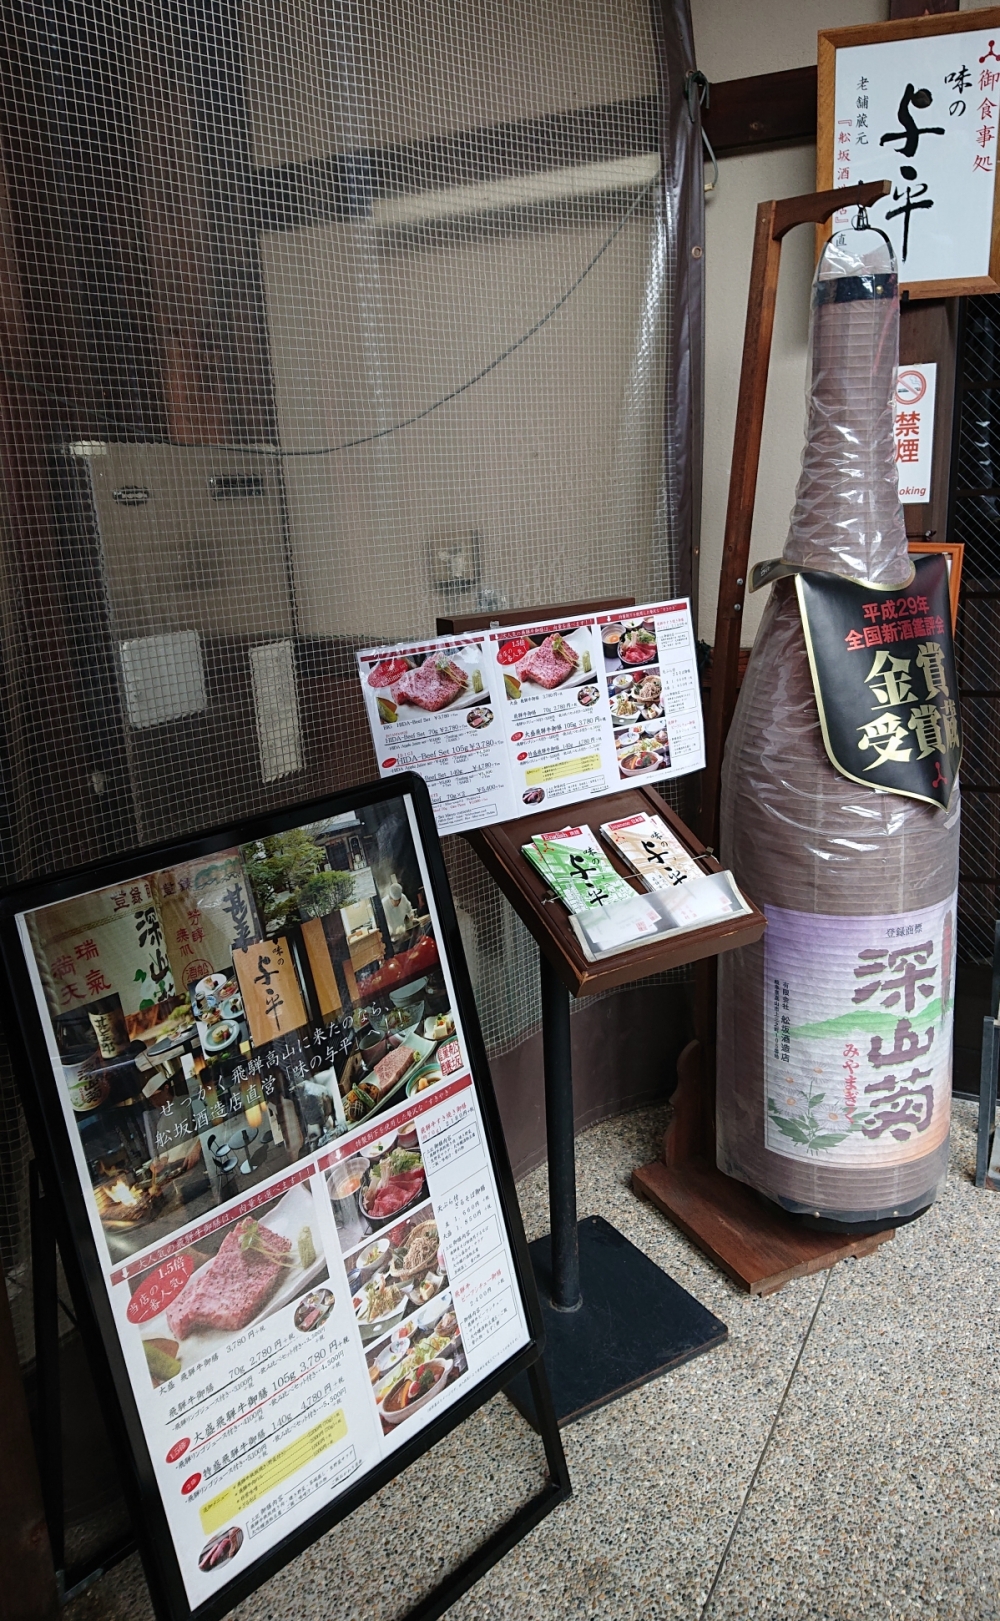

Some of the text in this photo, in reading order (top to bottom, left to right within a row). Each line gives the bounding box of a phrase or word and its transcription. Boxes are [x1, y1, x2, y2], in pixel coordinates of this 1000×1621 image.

[855, 76, 869, 146] 老舗蔵元
[944, 65, 973, 117] 味の
[972, 69, 1000, 173] 御食事処
[895, 411, 920, 462] 禁煙
[899, 487, 926, 497] oking
[844, 615, 945, 651] 全国新酒鑑評会
[862, 596, 930, 623] 平成29年
[864, 642, 950, 710] 金賞
[563, 721, 577, 730] 105g
[397, 750, 437, 765] HIDA-Beef
[452, 745, 469, 754] 105g
[469, 740, 494, 750] ¥3,780
[886, 923, 923, 938] 登録商標
[157, 997, 390, 1119] せっかく飛騨高山に来たのなら、
[851, 940, 938, 1141] 深山菊
[843, 1043, 860, 1124] みやまぎく
[157, 1256, 185, 1280] 1.5倍
[128, 1284, 159, 1315] 当店の
[157, 1378, 175, 1396] 大盛
[179, 1351, 219, 1382] 飛騨牛御膳
[167, 1381, 214, 1419] 飛騨牛御膳
[228, 1362, 245, 1381] 70g
[192, 1385, 268, 1445] 大盛飛騨牛御膳
[271, 1367, 296, 1393] 105g
[202, 1426, 266, 1479] 特盛飛騨牛御膳
[271, 1410, 292, 1431] 140g
